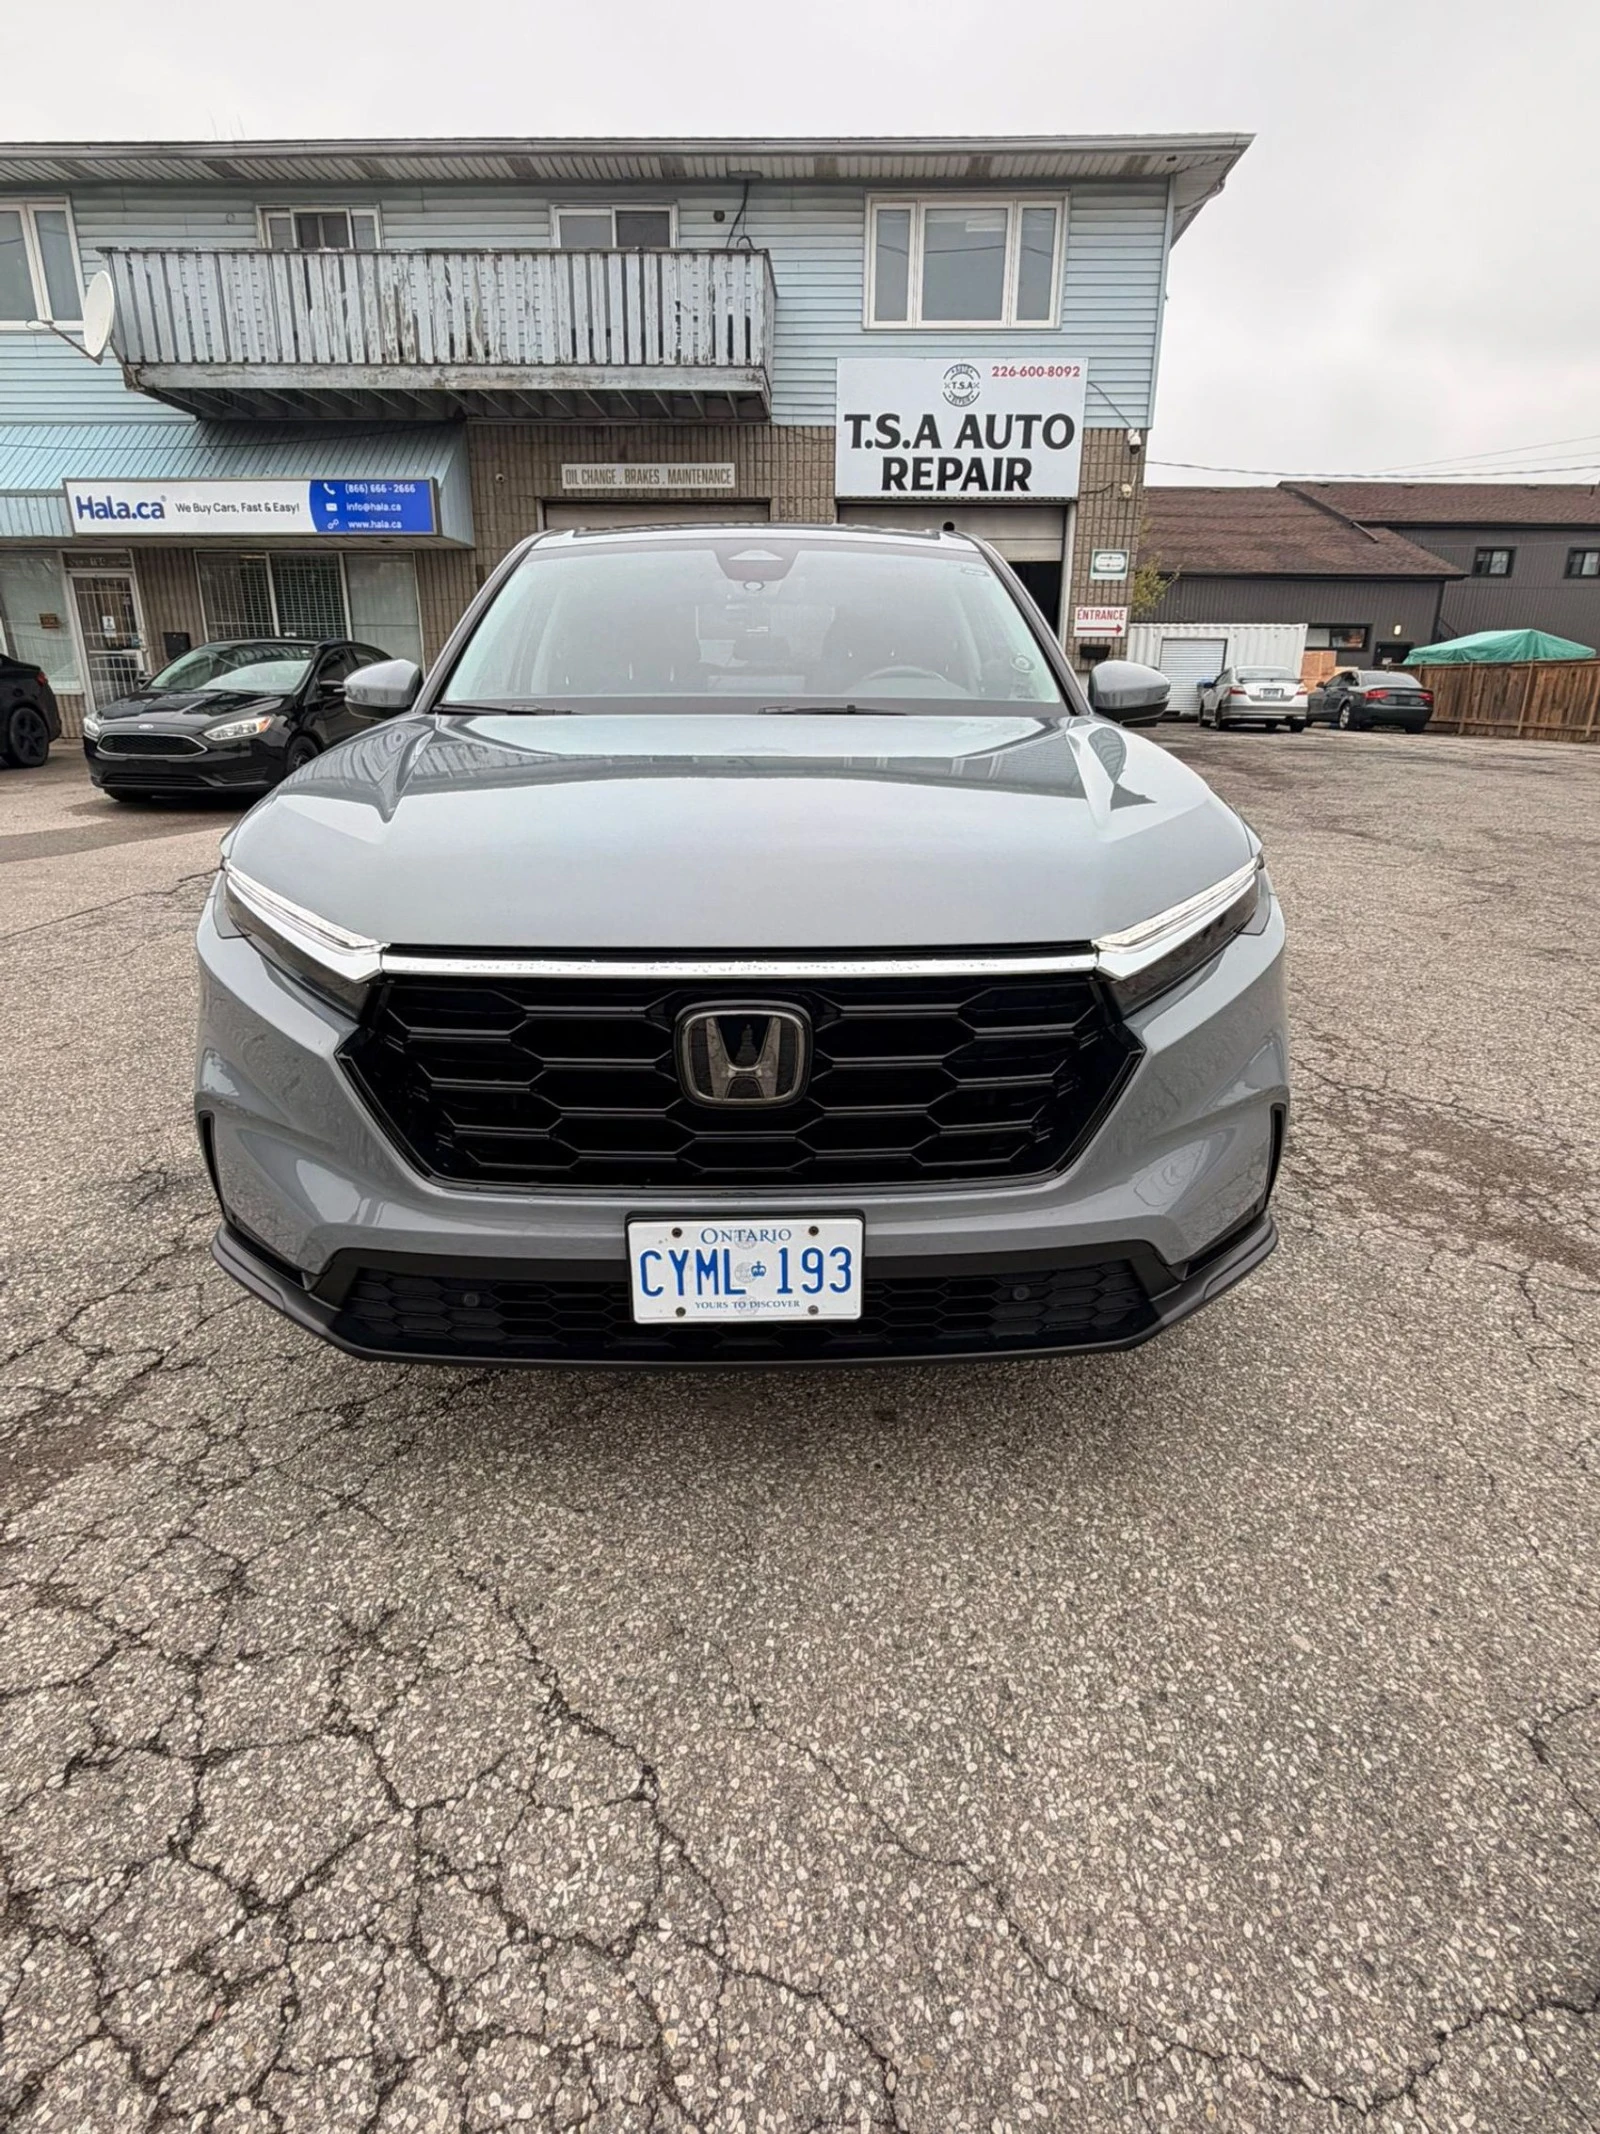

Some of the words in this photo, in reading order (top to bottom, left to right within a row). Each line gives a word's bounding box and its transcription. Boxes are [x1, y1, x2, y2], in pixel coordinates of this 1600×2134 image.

[991, 366, 1081, 378] 226-600-8092
[844, 413, 942, 450] T.S.A
[953, 413, 1075, 450] AUTO
[565, 469, 579, 485] OIL
[581, 469, 616, 485] CHANGE
[624, 469, 660, 485] BRAKES
[667, 468, 732, 485] MAINTENANCE
[881, 456, 1032, 491] REPAIR
[175, 503, 191, 513] We
[192, 503, 212, 515] Buy
[213, 502, 240, 513] Cars,
[241, 502, 262, 513] Fast
[264, 502, 272, 513] &
[273, 502, 300, 515] Easy!
[346, 503, 402, 512] info@hala.ca
[348, 520, 402, 529] www.hala.ca
[1077, 609, 1125, 621] ENTRANCE
[639, 1248, 746, 1297] CYML
[777, 1246, 852, 1295] 193
[695, 1301, 729, 1310] YOURS
[732, 1301, 748, 1310] TO
[750, 1300, 801, 1310] DISCOVER
